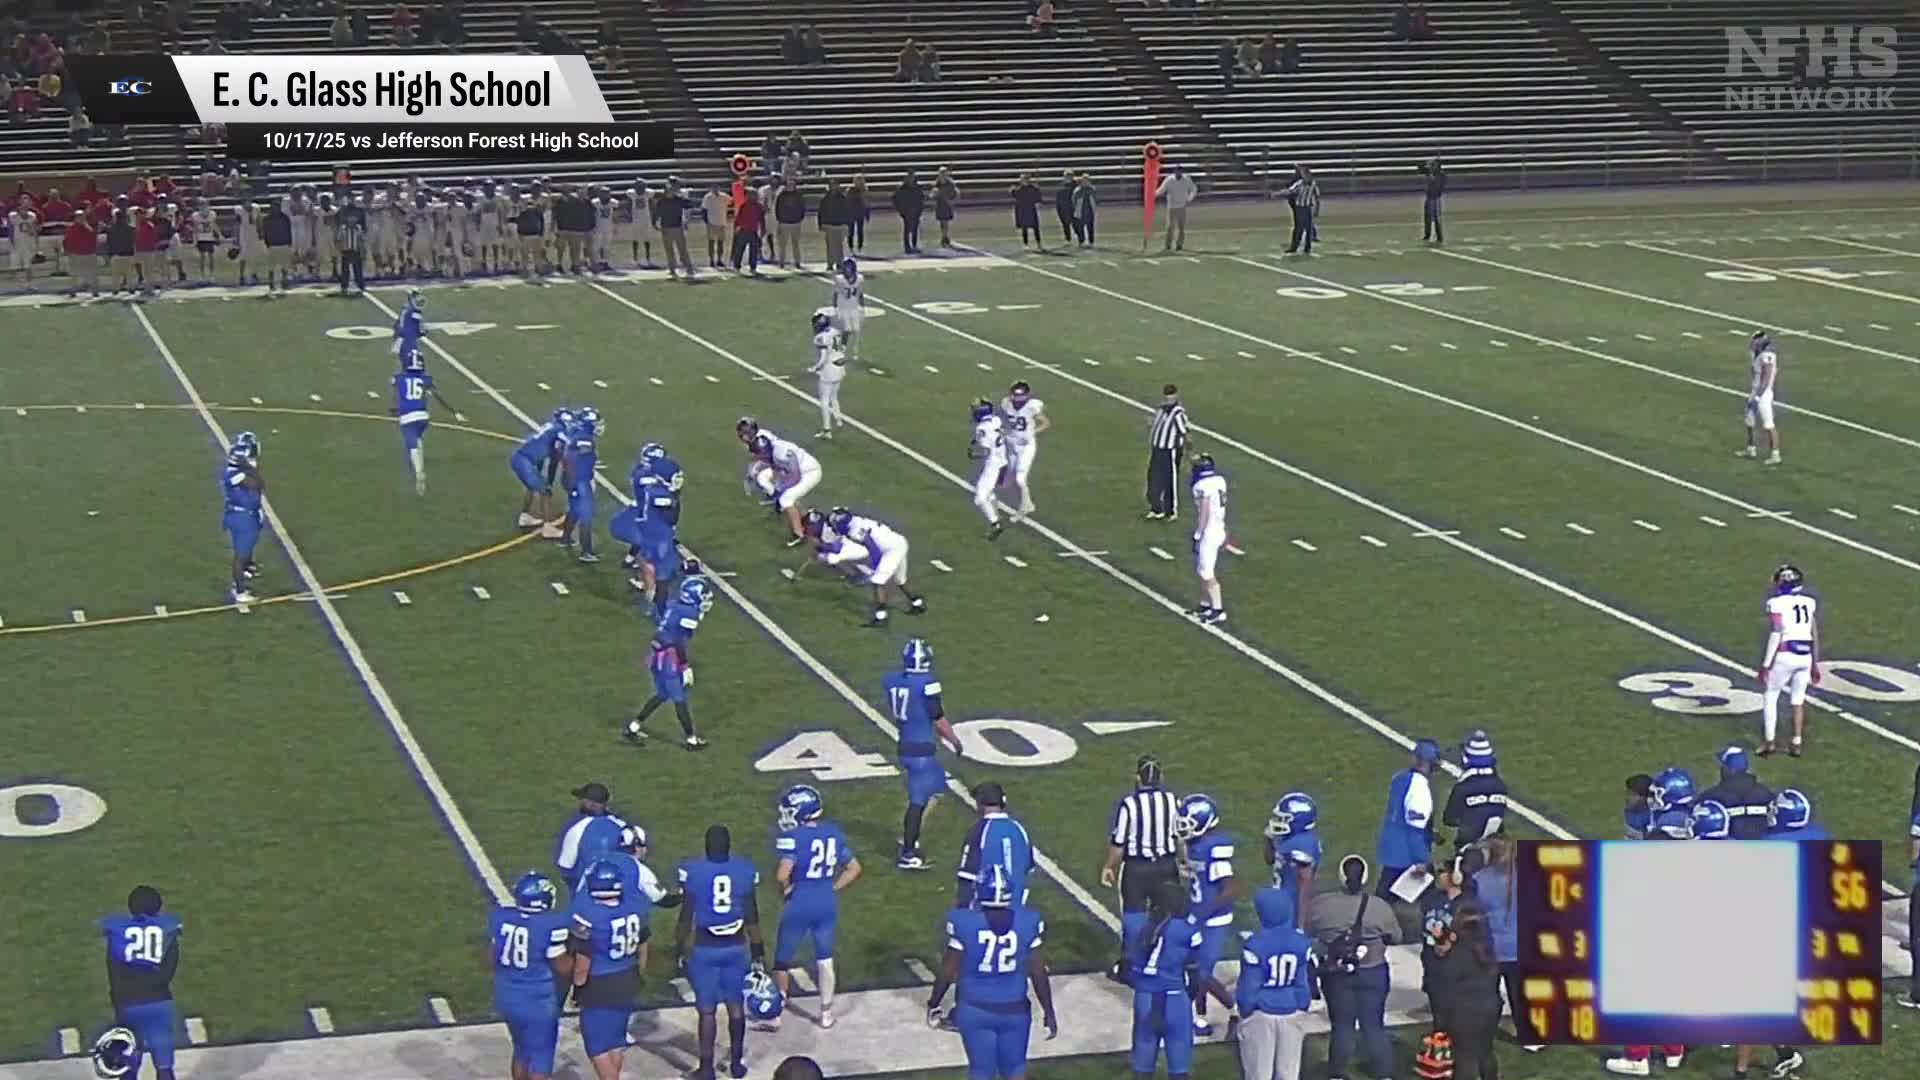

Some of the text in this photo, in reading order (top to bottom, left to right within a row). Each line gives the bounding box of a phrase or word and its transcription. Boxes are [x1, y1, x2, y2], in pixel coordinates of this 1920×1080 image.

[405, 377, 424, 400] 16
[1792, 604, 1809, 624] 11
[889, 686, 909, 721] 17
[712, 875, 732, 914] 8
[124, 925, 164, 963] 20
[500, 923, 528, 969] 78
[610, 913, 641, 961] 58
[978, 931, 1018, 973] 72
[1264, 953, 1298, 988] 10
